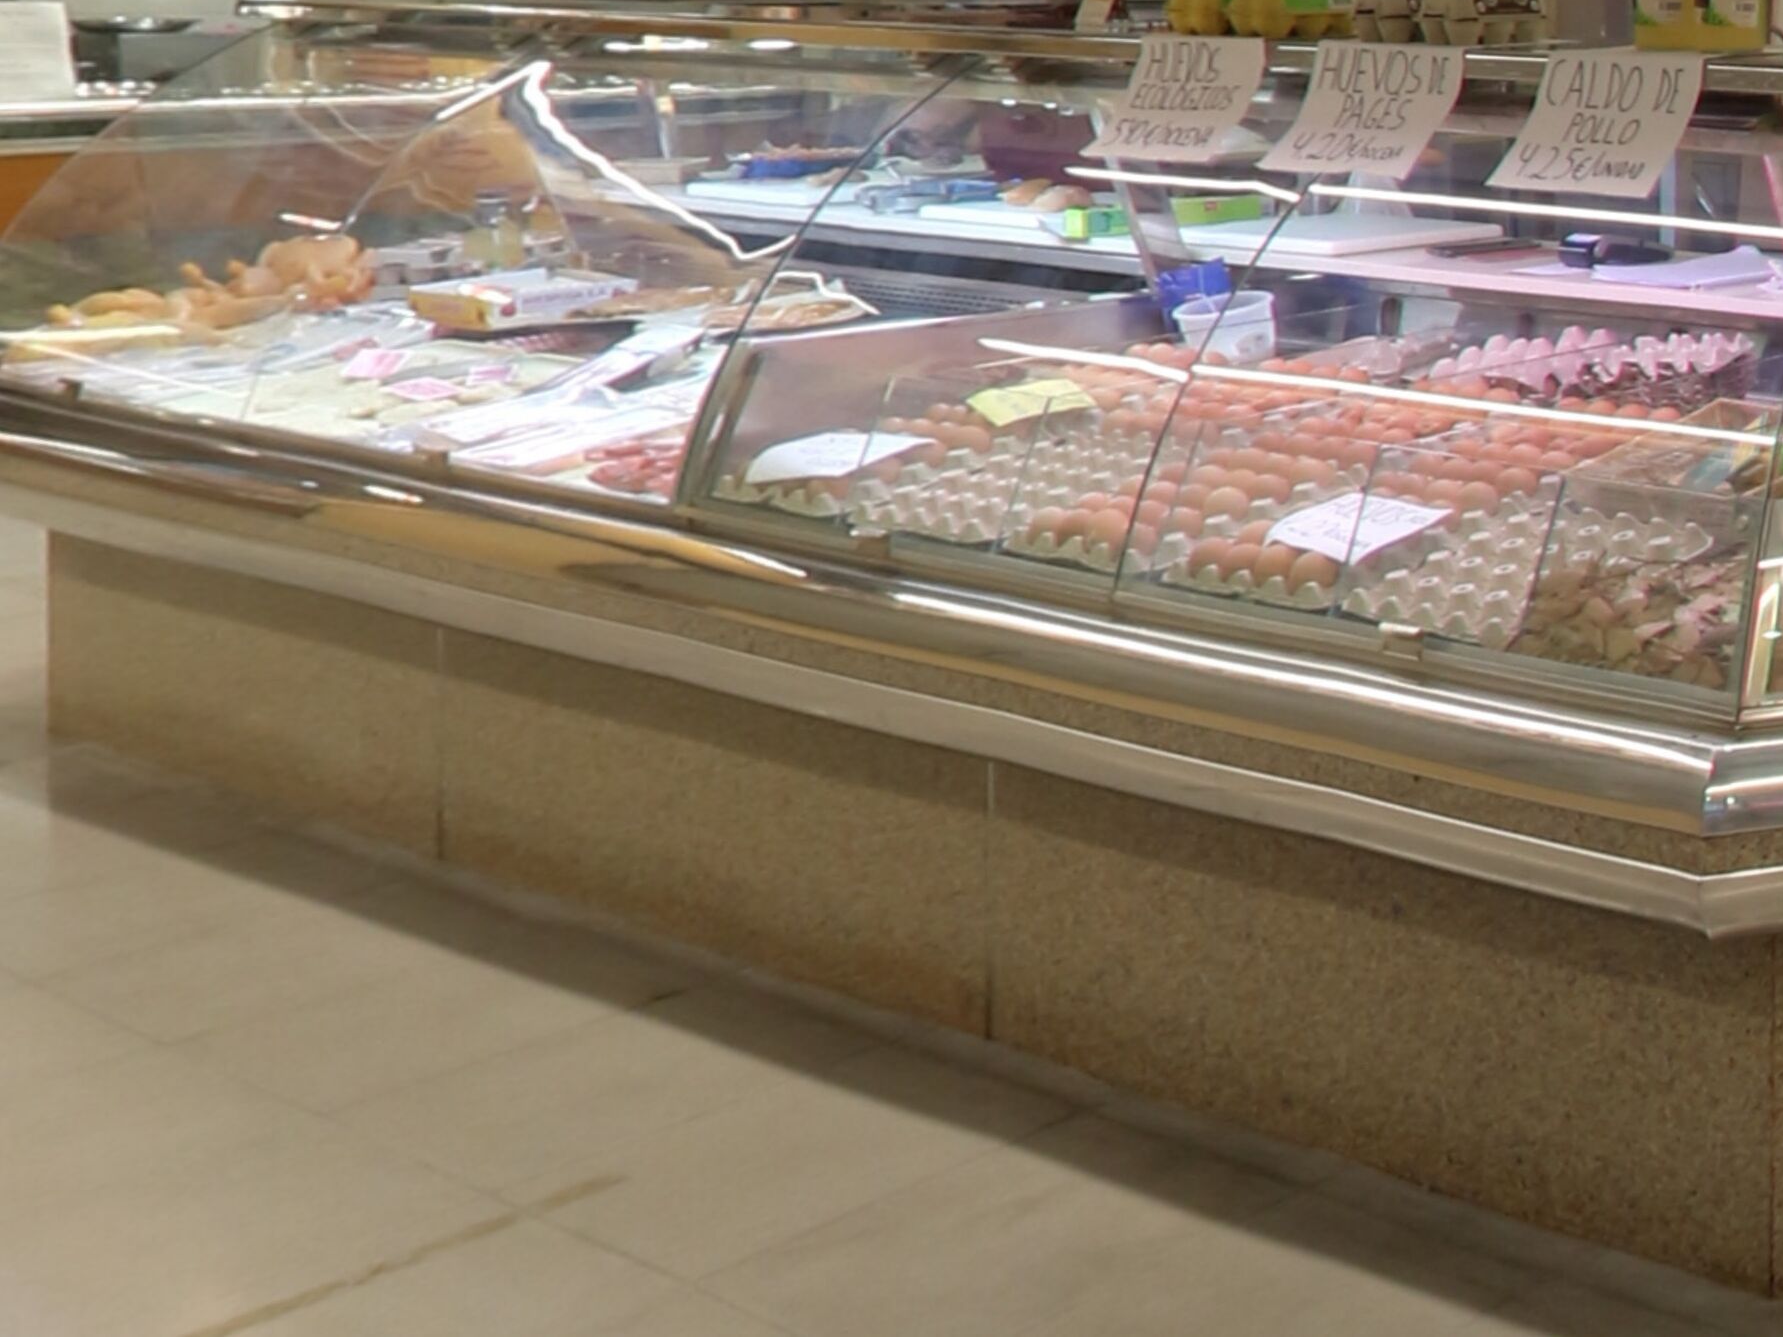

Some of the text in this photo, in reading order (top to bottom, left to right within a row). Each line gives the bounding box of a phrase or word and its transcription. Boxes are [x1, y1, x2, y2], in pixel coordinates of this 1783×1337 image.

[1317, 47, 1450, 96] HUEVOS DE
[1546, 59, 1685, 114] CALDO DE
[1562, 112, 1642, 145] POLLO
